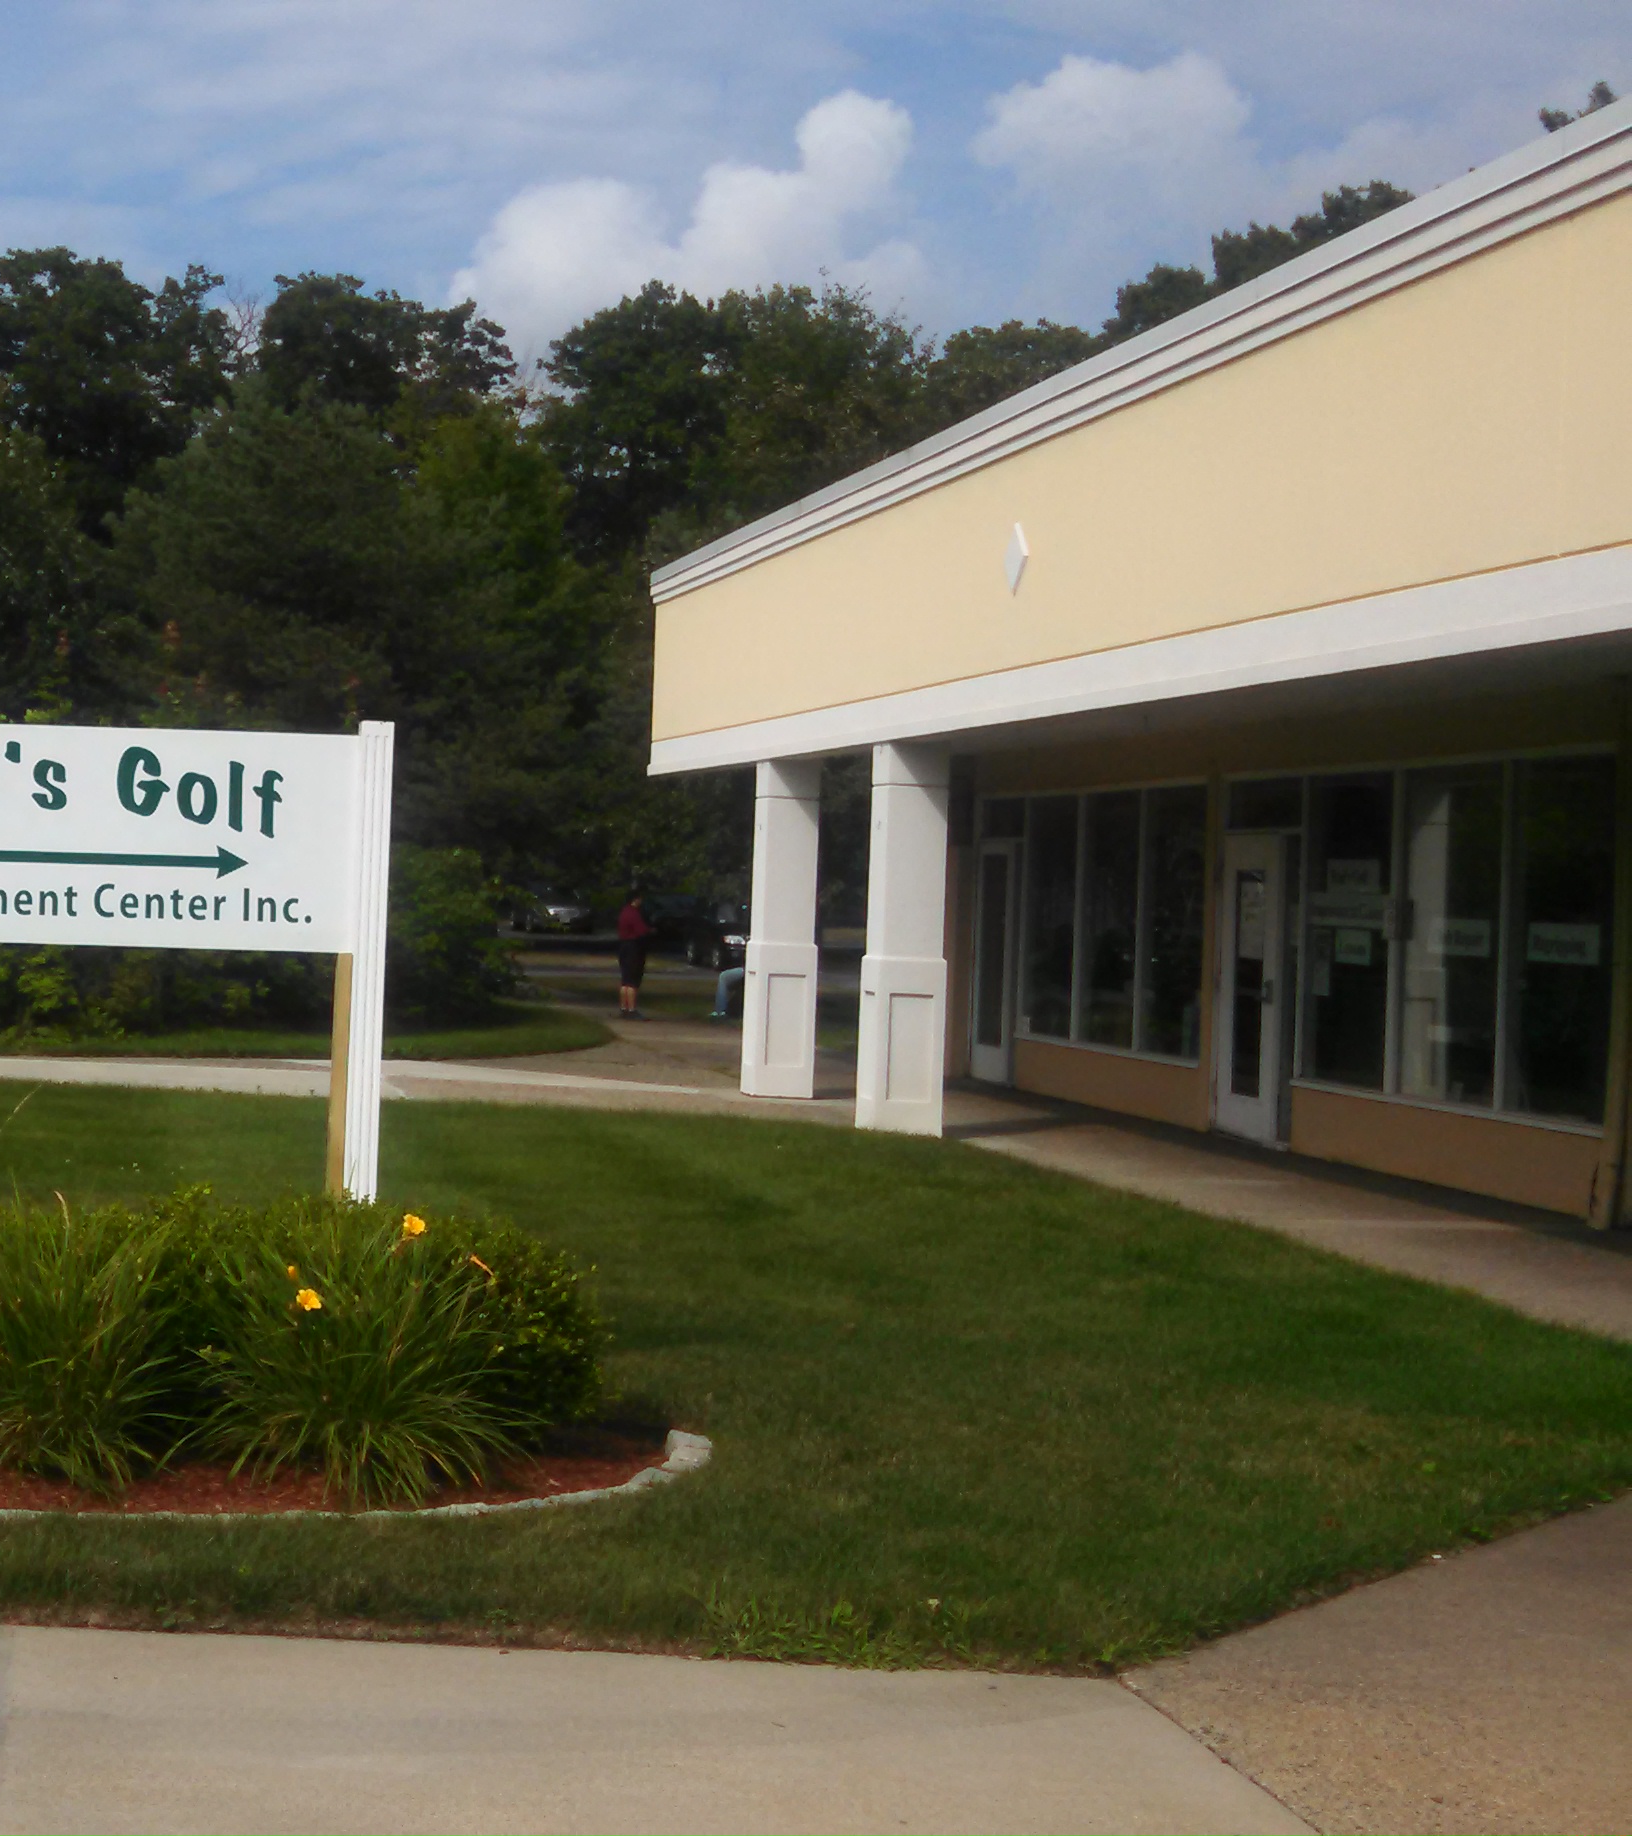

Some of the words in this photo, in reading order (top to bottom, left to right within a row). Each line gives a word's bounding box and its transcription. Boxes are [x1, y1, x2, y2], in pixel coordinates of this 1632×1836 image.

[116, 746, 284, 839] Golf
[93, 883, 227, 921] Center
[242, 887, 312, 924] Inc.
